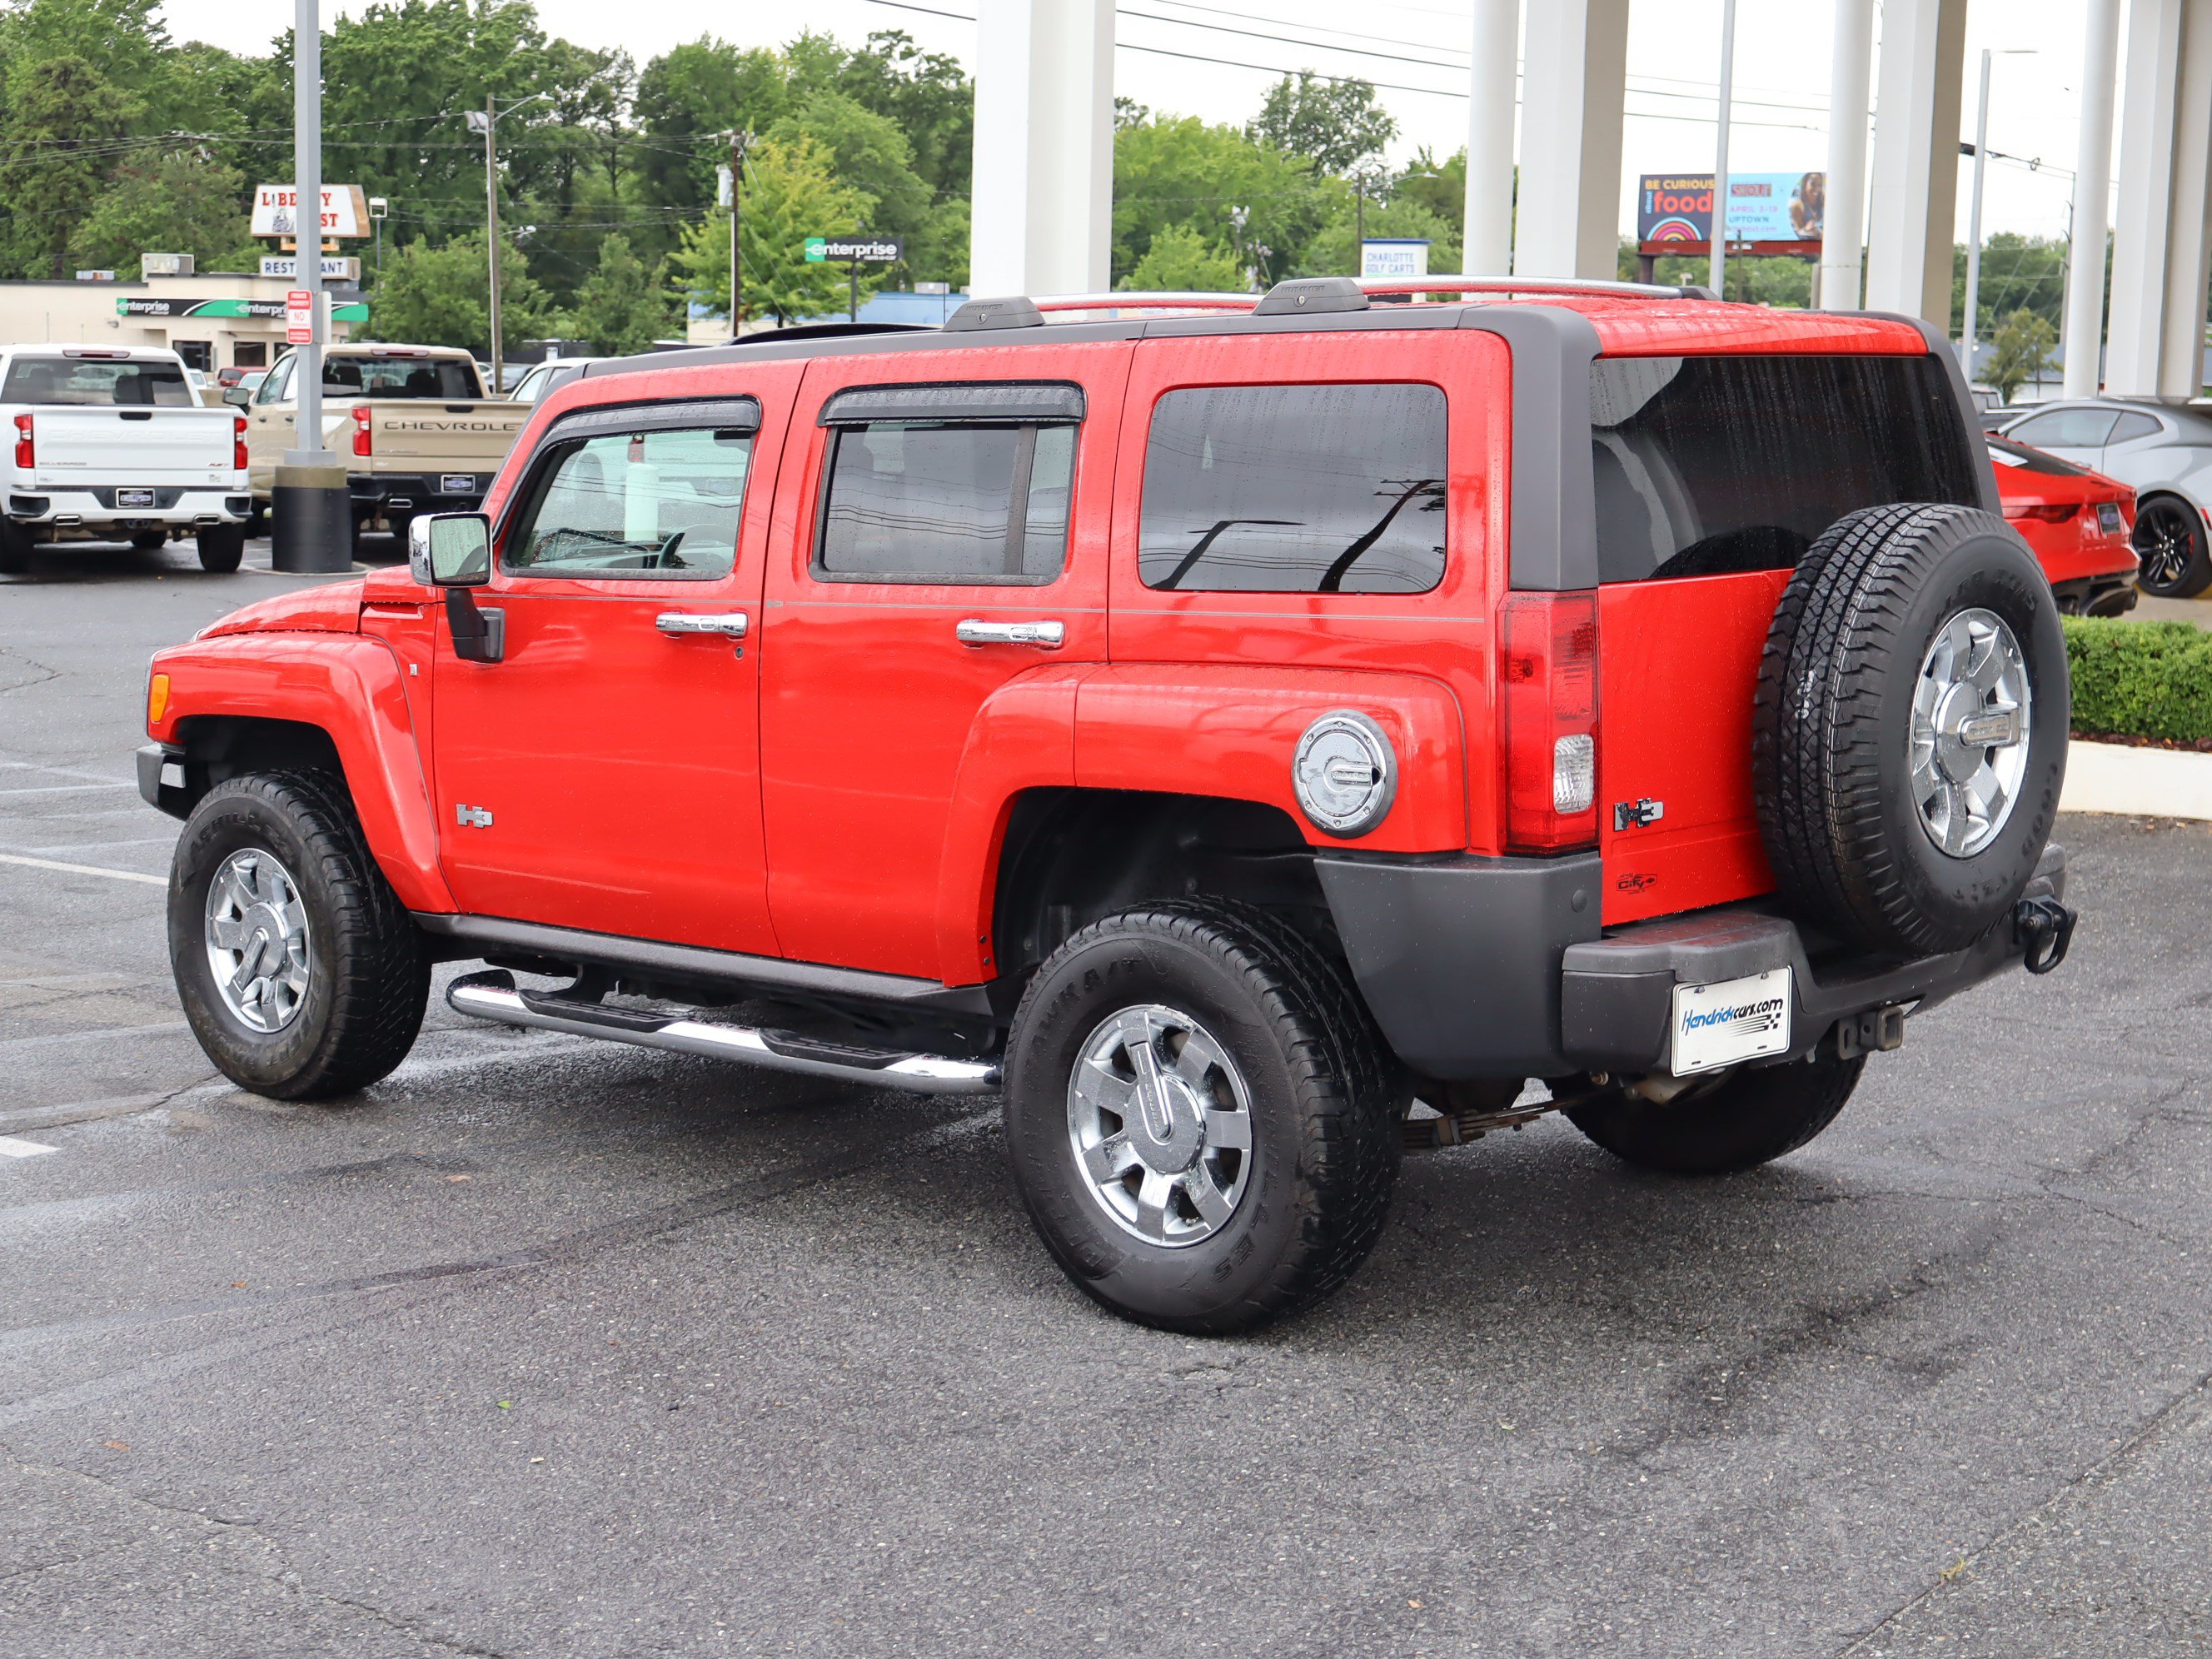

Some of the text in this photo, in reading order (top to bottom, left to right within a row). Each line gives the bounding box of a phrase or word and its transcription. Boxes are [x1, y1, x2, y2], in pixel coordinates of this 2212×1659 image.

[1646, 178, 1716, 190] BE CURIOUS
[262, 192, 331, 207] LIBEY
[1654, 190, 1713, 213] food
[805, 241, 897, 259] enterprise
[1367, 253, 1414, 263] CHARLOTTE
[265, 262, 343, 274] RESTANT
[1366, 264, 1415, 275] GOLF CARTS
[1281, 285, 1326, 293] HUMMER
[117, 301, 170, 313] enterprise
[294, 311, 306, 321] NO
[385, 421, 523, 431] CHEVROLE
[1681, 998, 1784, 1037] Hendrickcars.com
